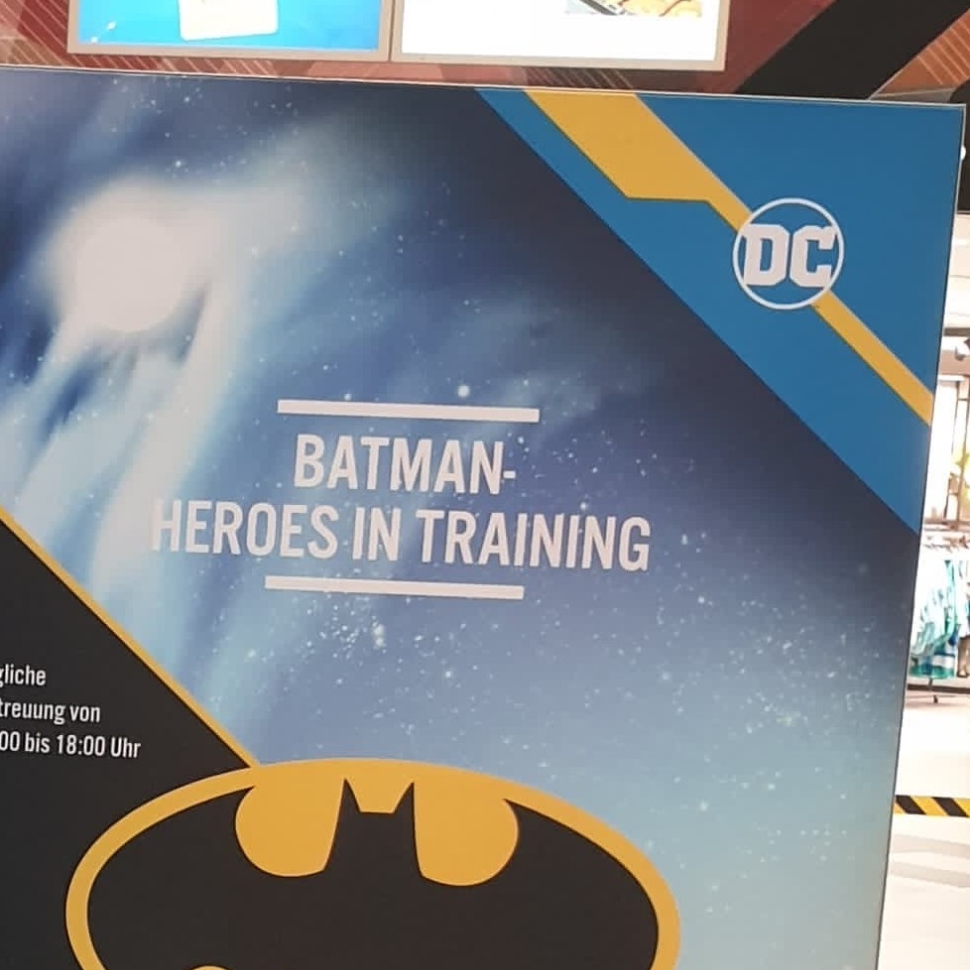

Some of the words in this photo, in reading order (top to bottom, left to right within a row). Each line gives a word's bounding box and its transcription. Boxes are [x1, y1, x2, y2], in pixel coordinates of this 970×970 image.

[734, 222, 838, 290] DC
[294, 434, 516, 494] BATMAN-
[151, 499, 340, 559] HEROES
[352, 506, 401, 561] IN
[415, 508, 651, 572] TRAINING
[69, 705, 101, 723] von
[24, 732, 50, 754] bis
[56, 734, 106, 757] 18:00
[110, 736, 142, 758] Uhr
